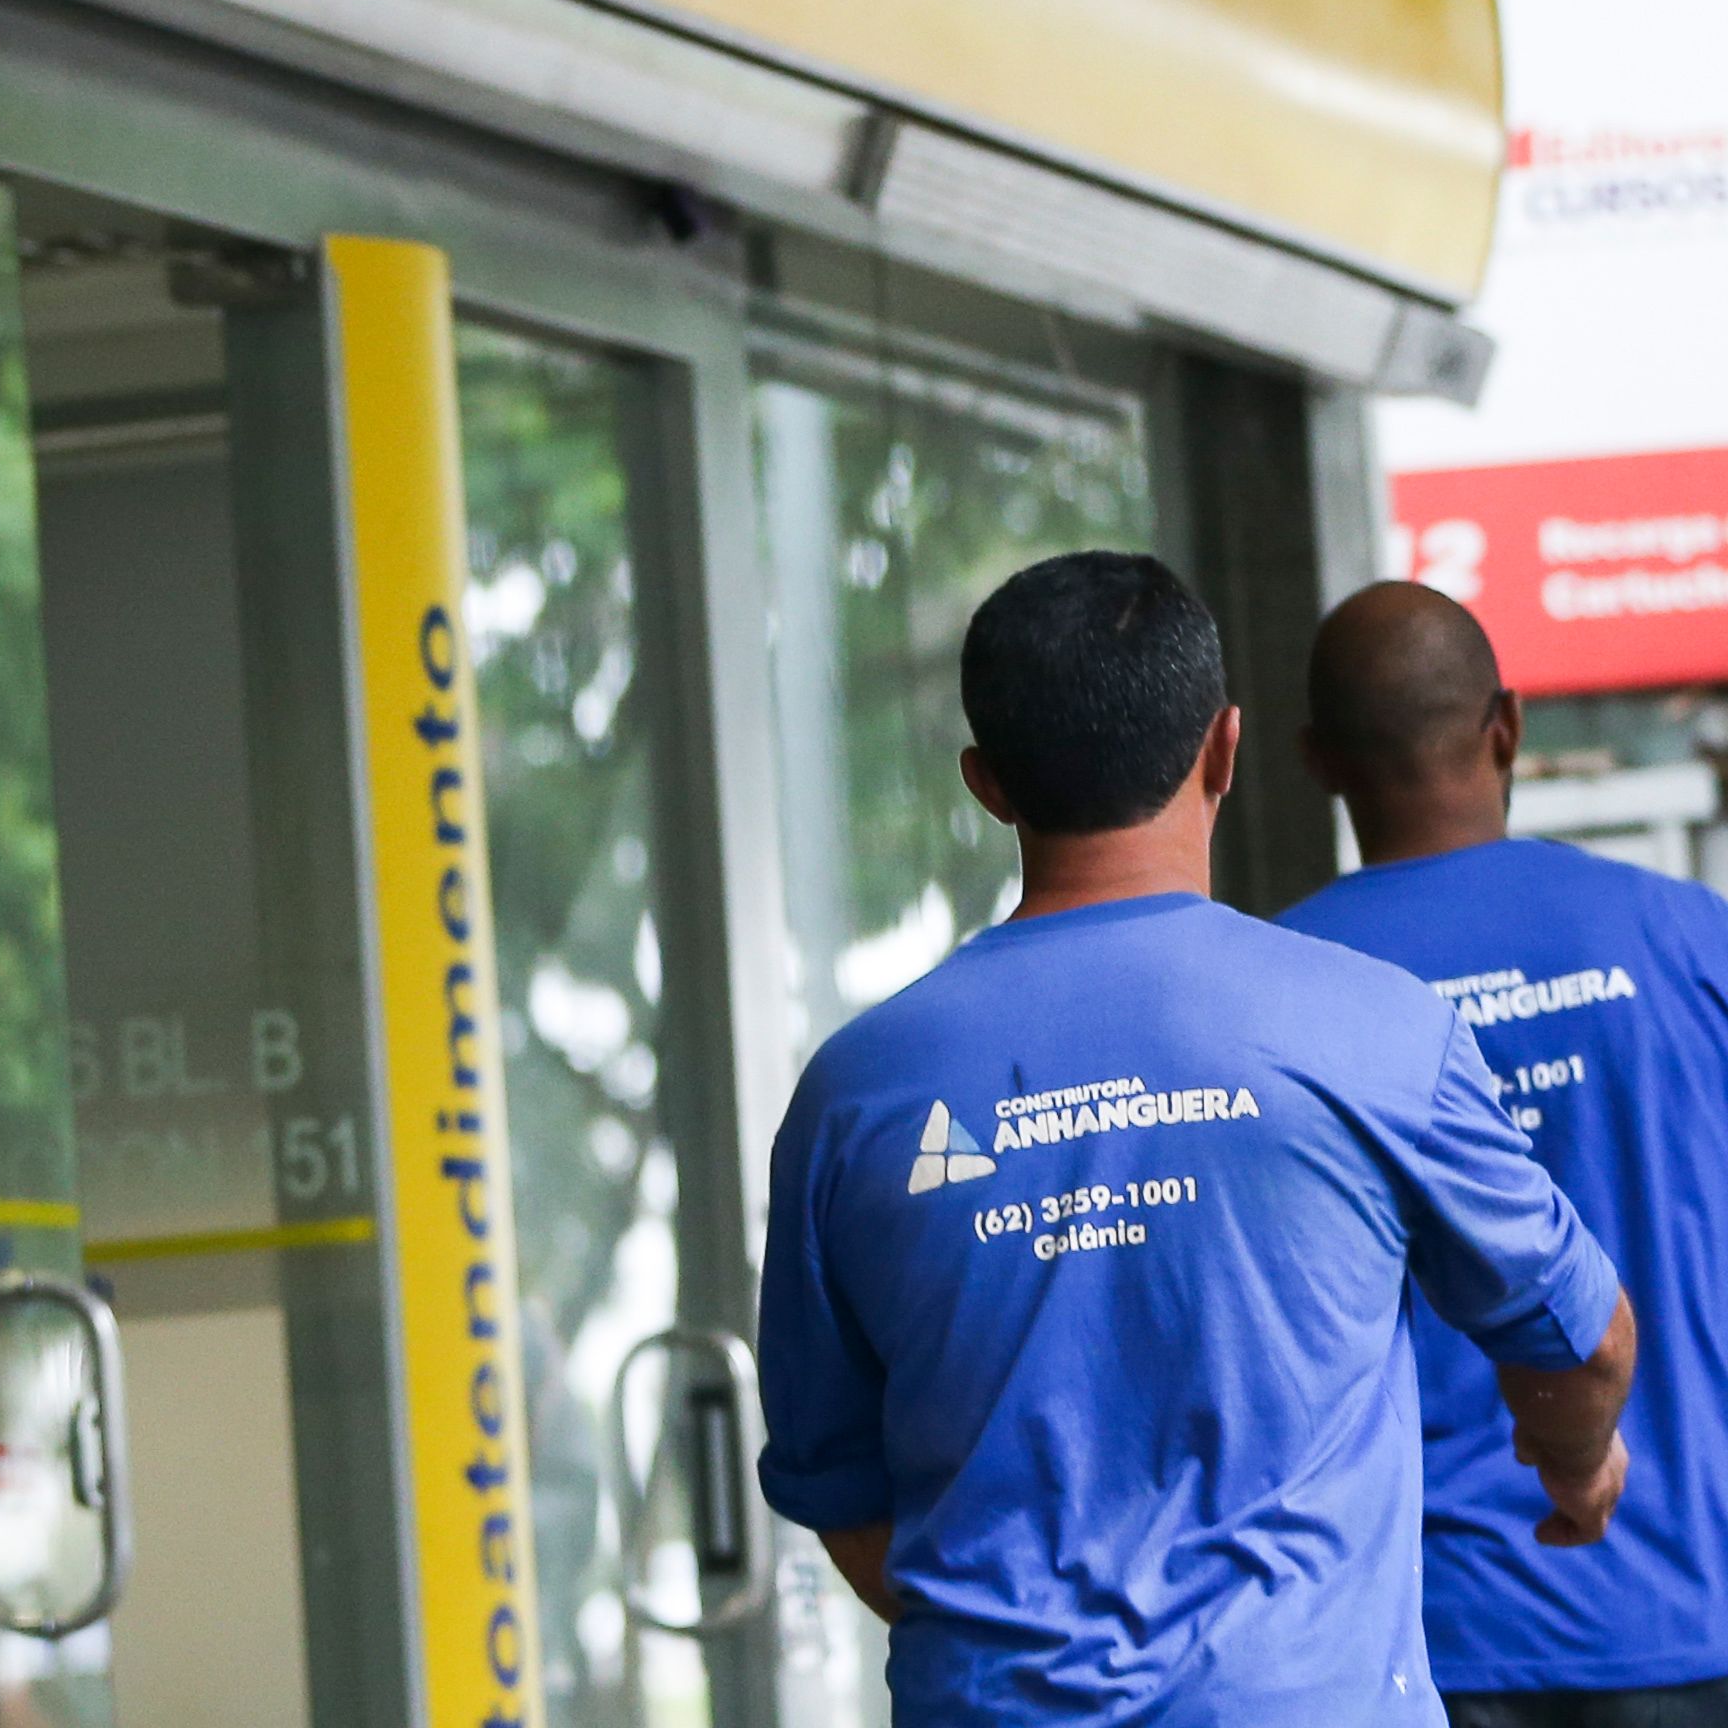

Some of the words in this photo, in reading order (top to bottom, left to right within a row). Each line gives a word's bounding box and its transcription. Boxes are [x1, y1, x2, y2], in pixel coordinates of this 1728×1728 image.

[1524, 170, 1728, 221] CURSOS
[993, 1087, 1261, 1154] ANHANGUERA
[995, 1076, 1146, 1119] CONSTRUTORA
[974, 1202, 1033, 1243] (62)
[1040, 1176, 1198, 1223] 3259-1001
[1033, 1219, 1147, 1261] Goiânia
